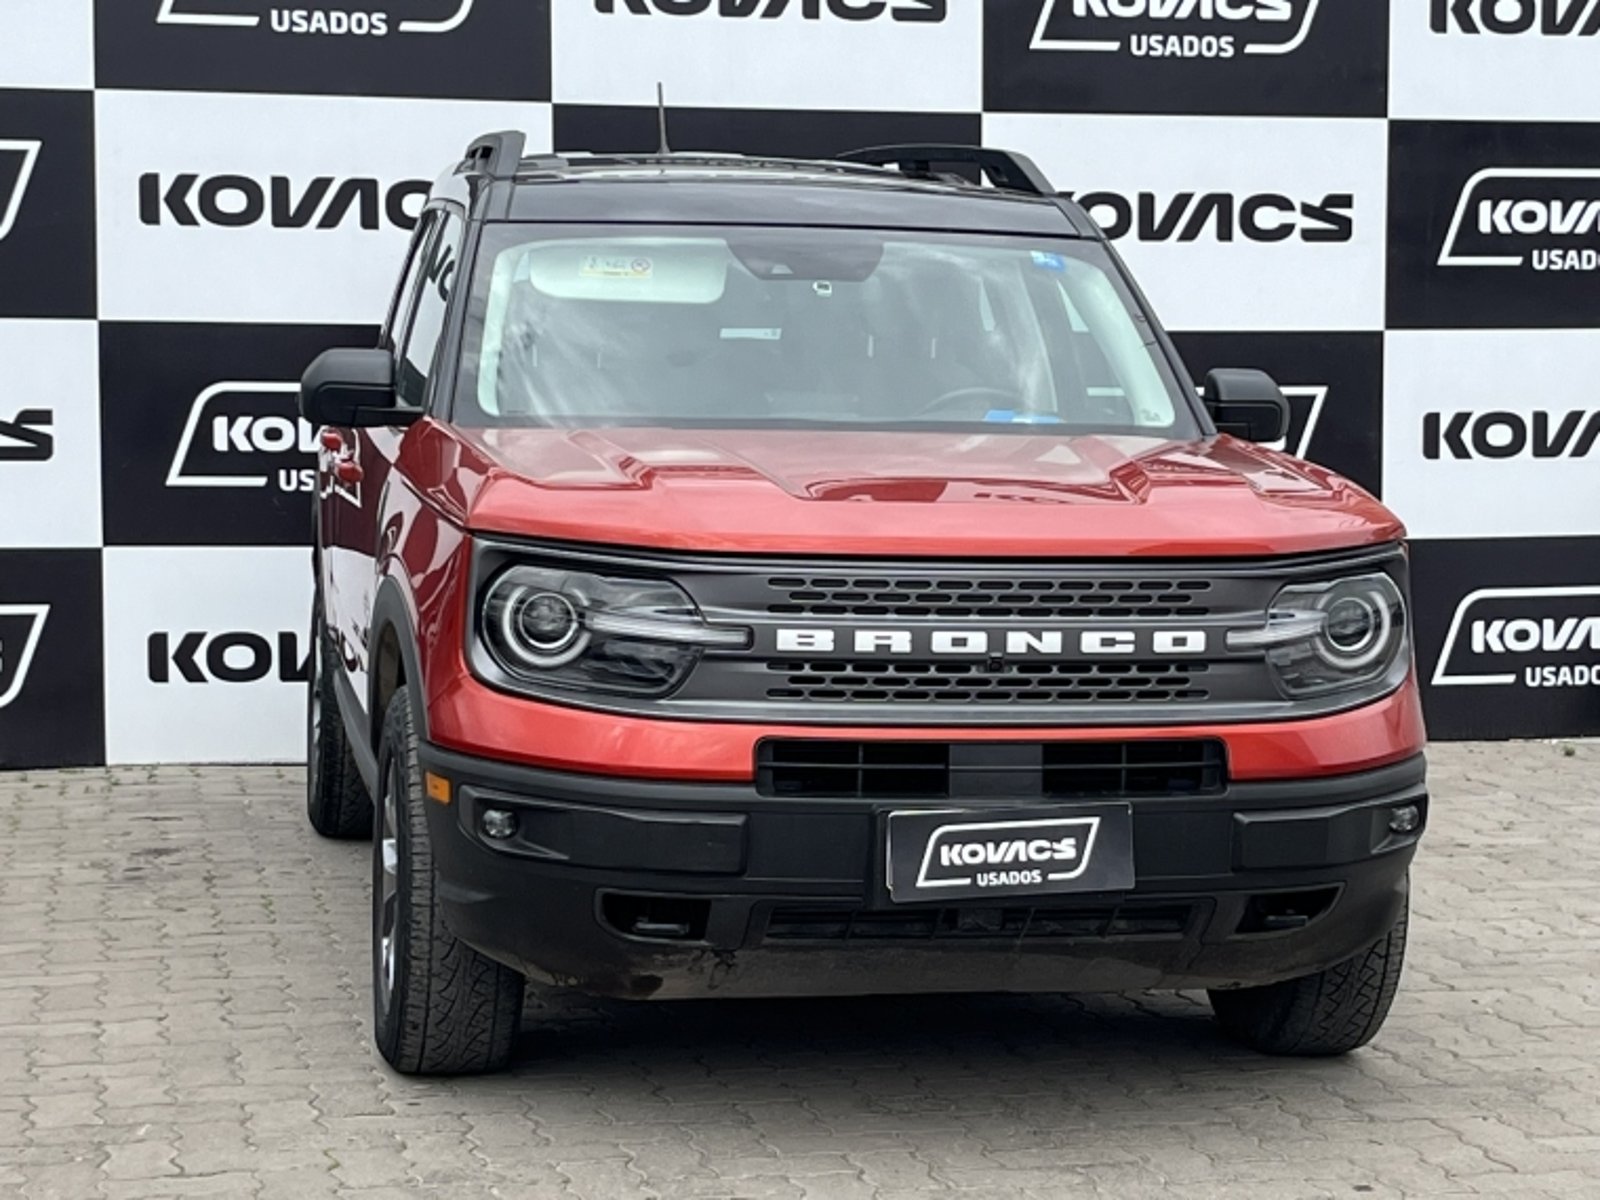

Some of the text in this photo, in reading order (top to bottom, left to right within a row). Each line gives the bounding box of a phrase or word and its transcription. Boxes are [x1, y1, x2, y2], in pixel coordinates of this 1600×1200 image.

[271, 10, 388, 36] USADOS
[1130, 35, 1235, 58] USADOS
[1050, 191, 1354, 242] OVACS
[1532, 249, 1600, 271] USAD
[776, 628, 1207, 654] BRONCO
[1471, 616, 1600, 654] KOVA
[940, 838, 1077, 866] KOVACS
[976, 870, 1042, 887] USADOS
